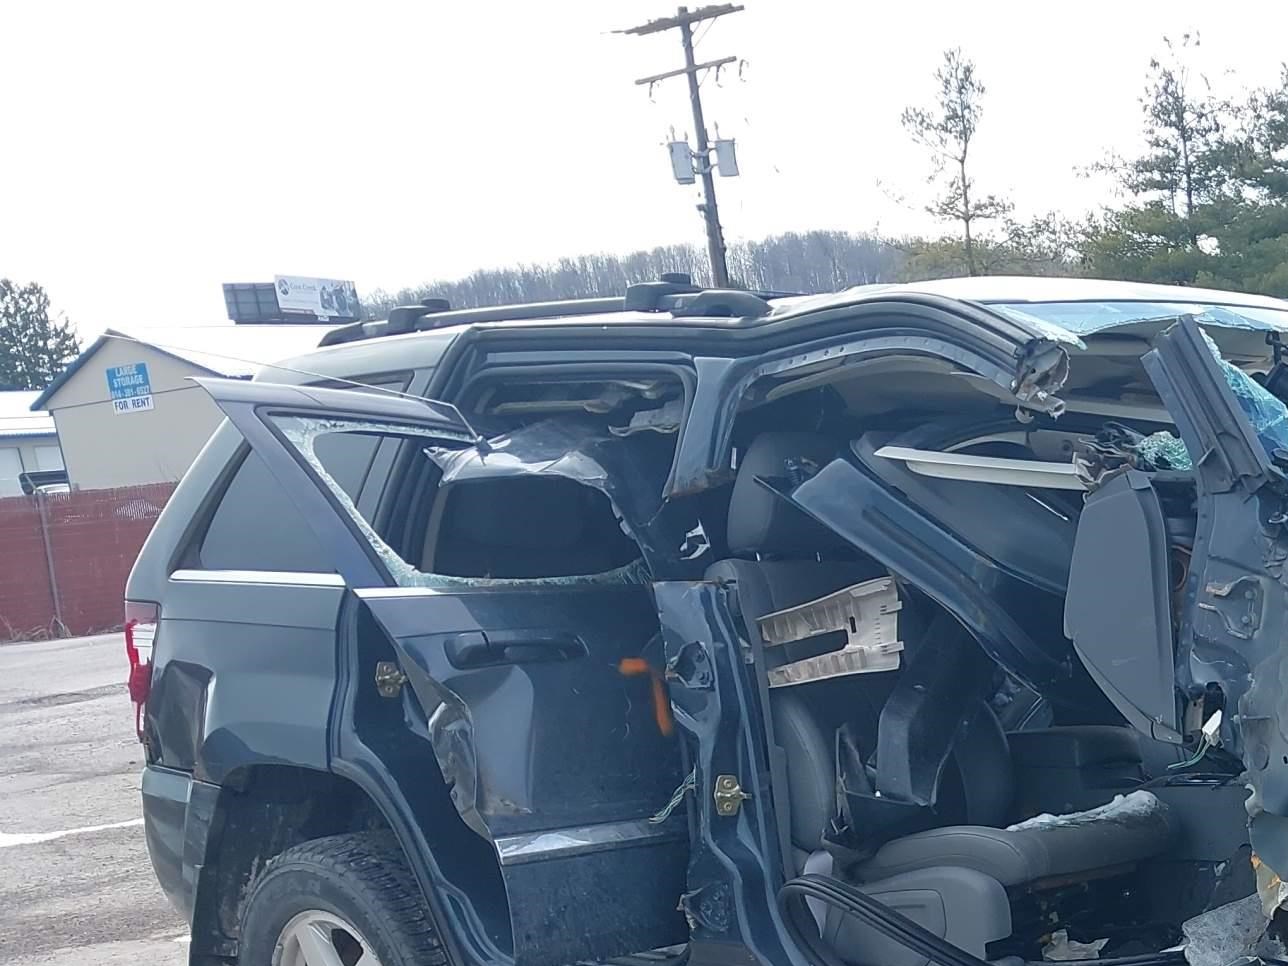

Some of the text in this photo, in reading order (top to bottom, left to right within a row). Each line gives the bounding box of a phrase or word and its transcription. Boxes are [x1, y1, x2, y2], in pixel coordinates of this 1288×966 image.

[112, 375, 145, 389] STORAGE
[114, 397, 151, 412] FOR RENT
